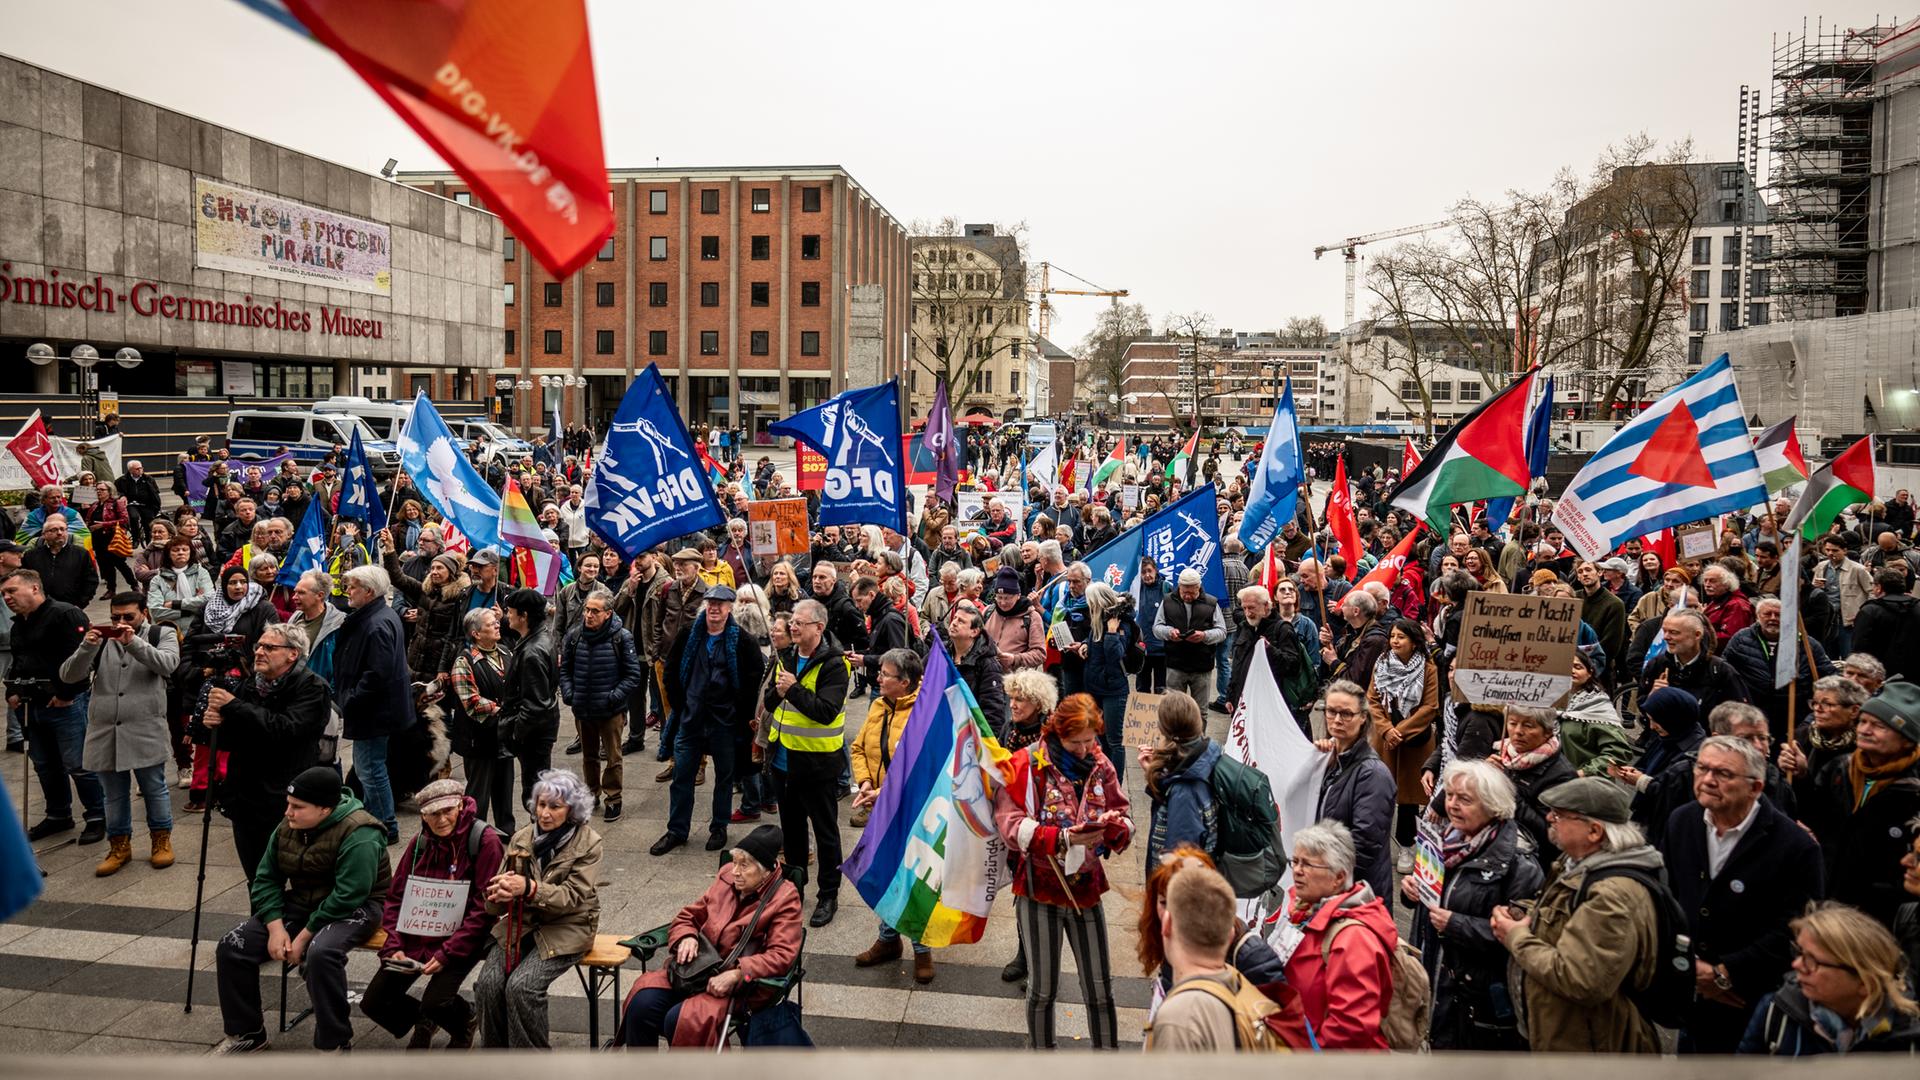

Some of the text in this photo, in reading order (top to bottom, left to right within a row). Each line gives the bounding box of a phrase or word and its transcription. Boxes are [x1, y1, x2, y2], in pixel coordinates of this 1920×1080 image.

[279, 266, 300, 275] ZEIGEN
[1575, 511, 1586, 523] DER
[1472, 597, 1575, 622] Männer der Macht
[1472, 621, 1522, 645] entwaffnen
[1555, 627, 1576, 644] West
[1522, 646, 1548, 665] Kriege
[1471, 672, 1552, 689] Die Zukunft ist
[1482, 685, 1545, 701] feministisch!
[410, 884, 454, 899] FRIEDEN
[411, 907, 439, 918] OHNE
[403, 919, 457, 932] WAFFEN!
